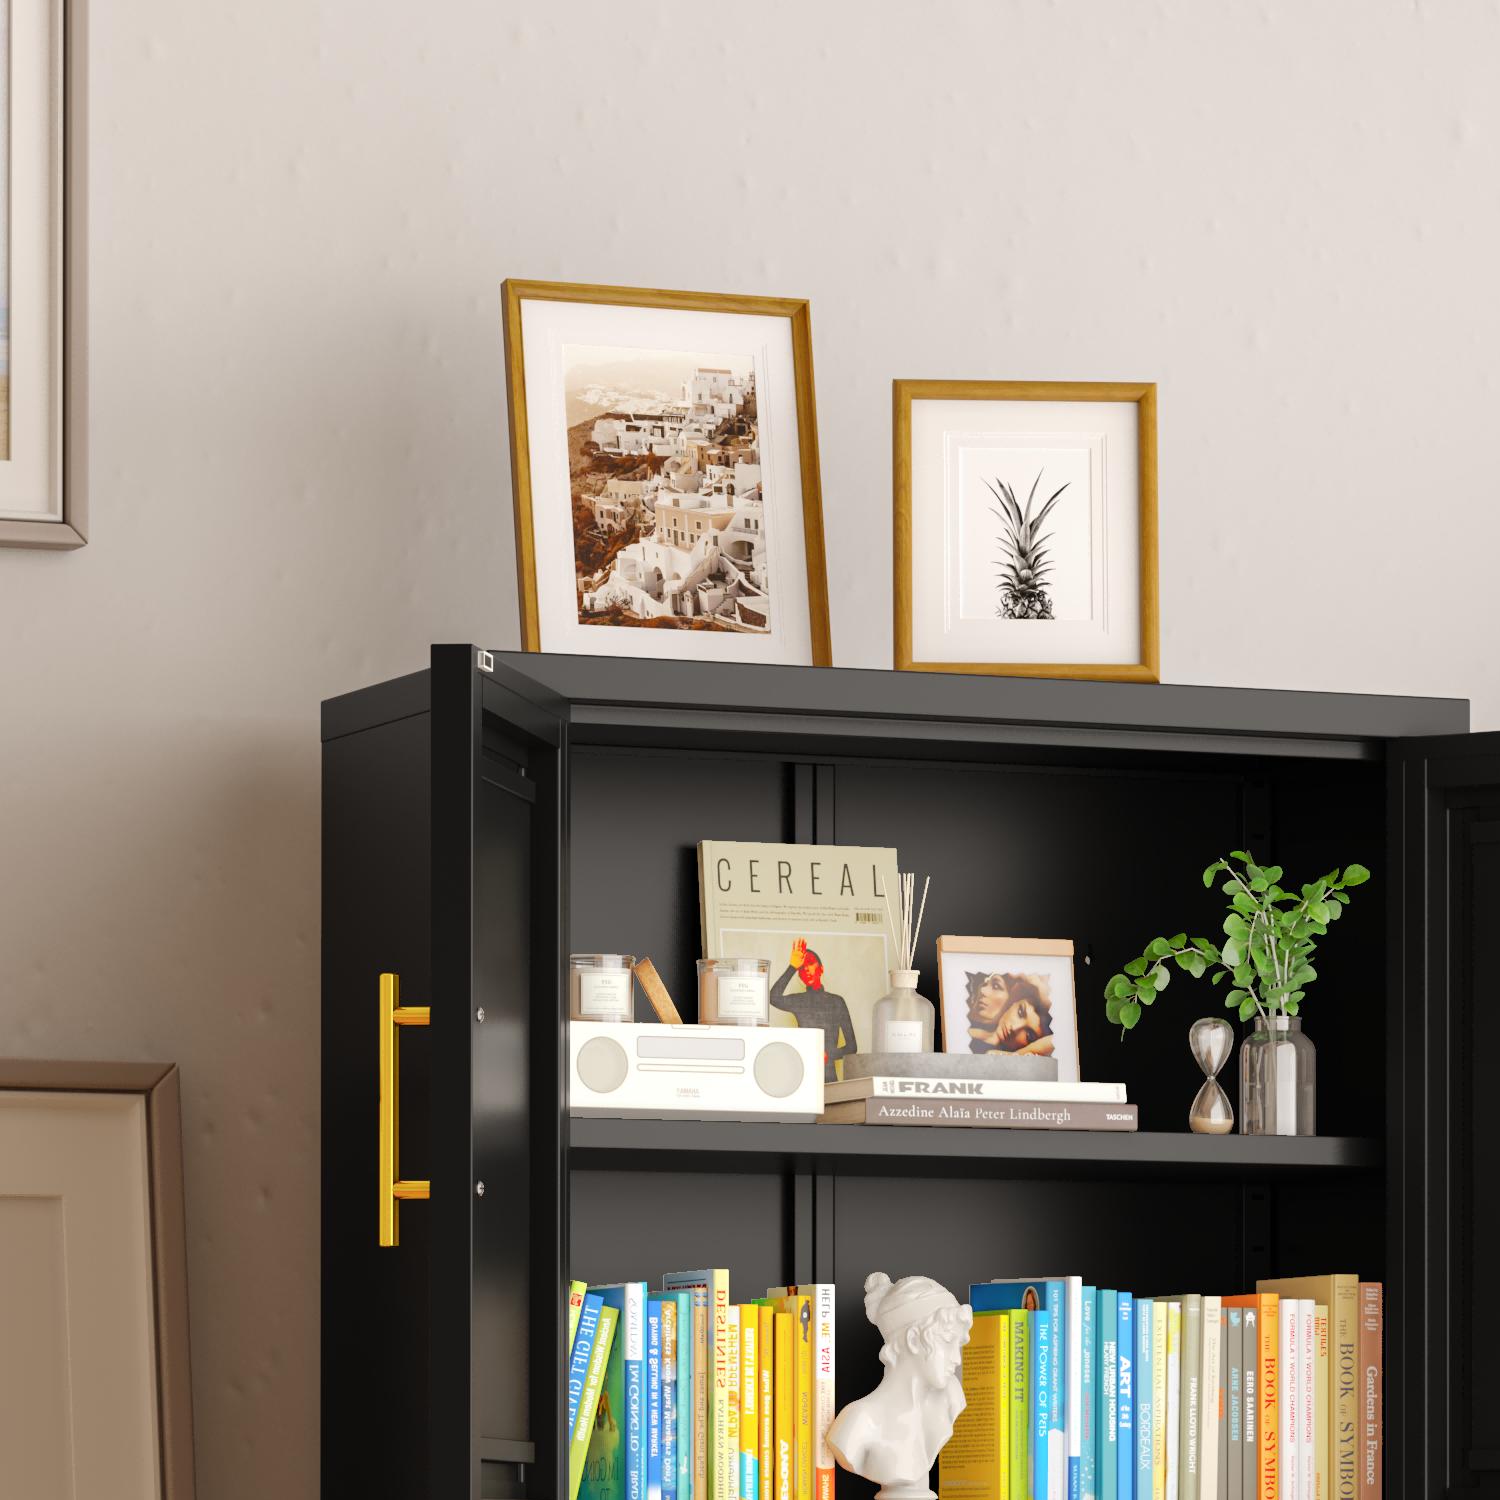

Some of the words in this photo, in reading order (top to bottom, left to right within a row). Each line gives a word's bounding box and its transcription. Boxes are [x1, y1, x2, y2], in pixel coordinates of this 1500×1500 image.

[717, 858, 885, 897] CEREAL
[898, 1081, 984, 1095] FRANK
[878, 1104, 934, 1118] Azzedine
[975, 1108, 1005, 1121] Peter
[1009, 1107, 1071, 1125] Lindbergh
[1106, 1113, 1133, 1121] TASCHEN
[1083, 1301, 1092, 1321] Love
[1015, 1321, 1024, 1382] MAKING
[1039, 1346, 1049, 1387] POWER
[1109, 1341, 1117, 1364] NEW
[1109, 1366, 1117, 1398] URBAN
[1119, 1355, 1131, 1398] ART
[1232, 1368, 1240, 1391] ARNE
[1264, 1358, 1276, 1410] BOOK
[1339, 1343, 1354, 1399] BOOK
[1015, 1387, 1024, 1403] IT
[1039, 1391, 1049, 1409] OF
[1189, 1376, 1198, 1406] FRANK
[1366, 1366, 1378, 1420] Gardens
[1109, 1399, 1117, 1442] HOUSING
[1139, 1403, 1151, 1470] BORDEAUX
[1189, 1408, 1198, 1436] LLOYD
[1366, 1423, 1378, 1437] in
[1189, 1438, 1198, 1475] WRIGHT
[1366, 1439, 1378, 1486] France
